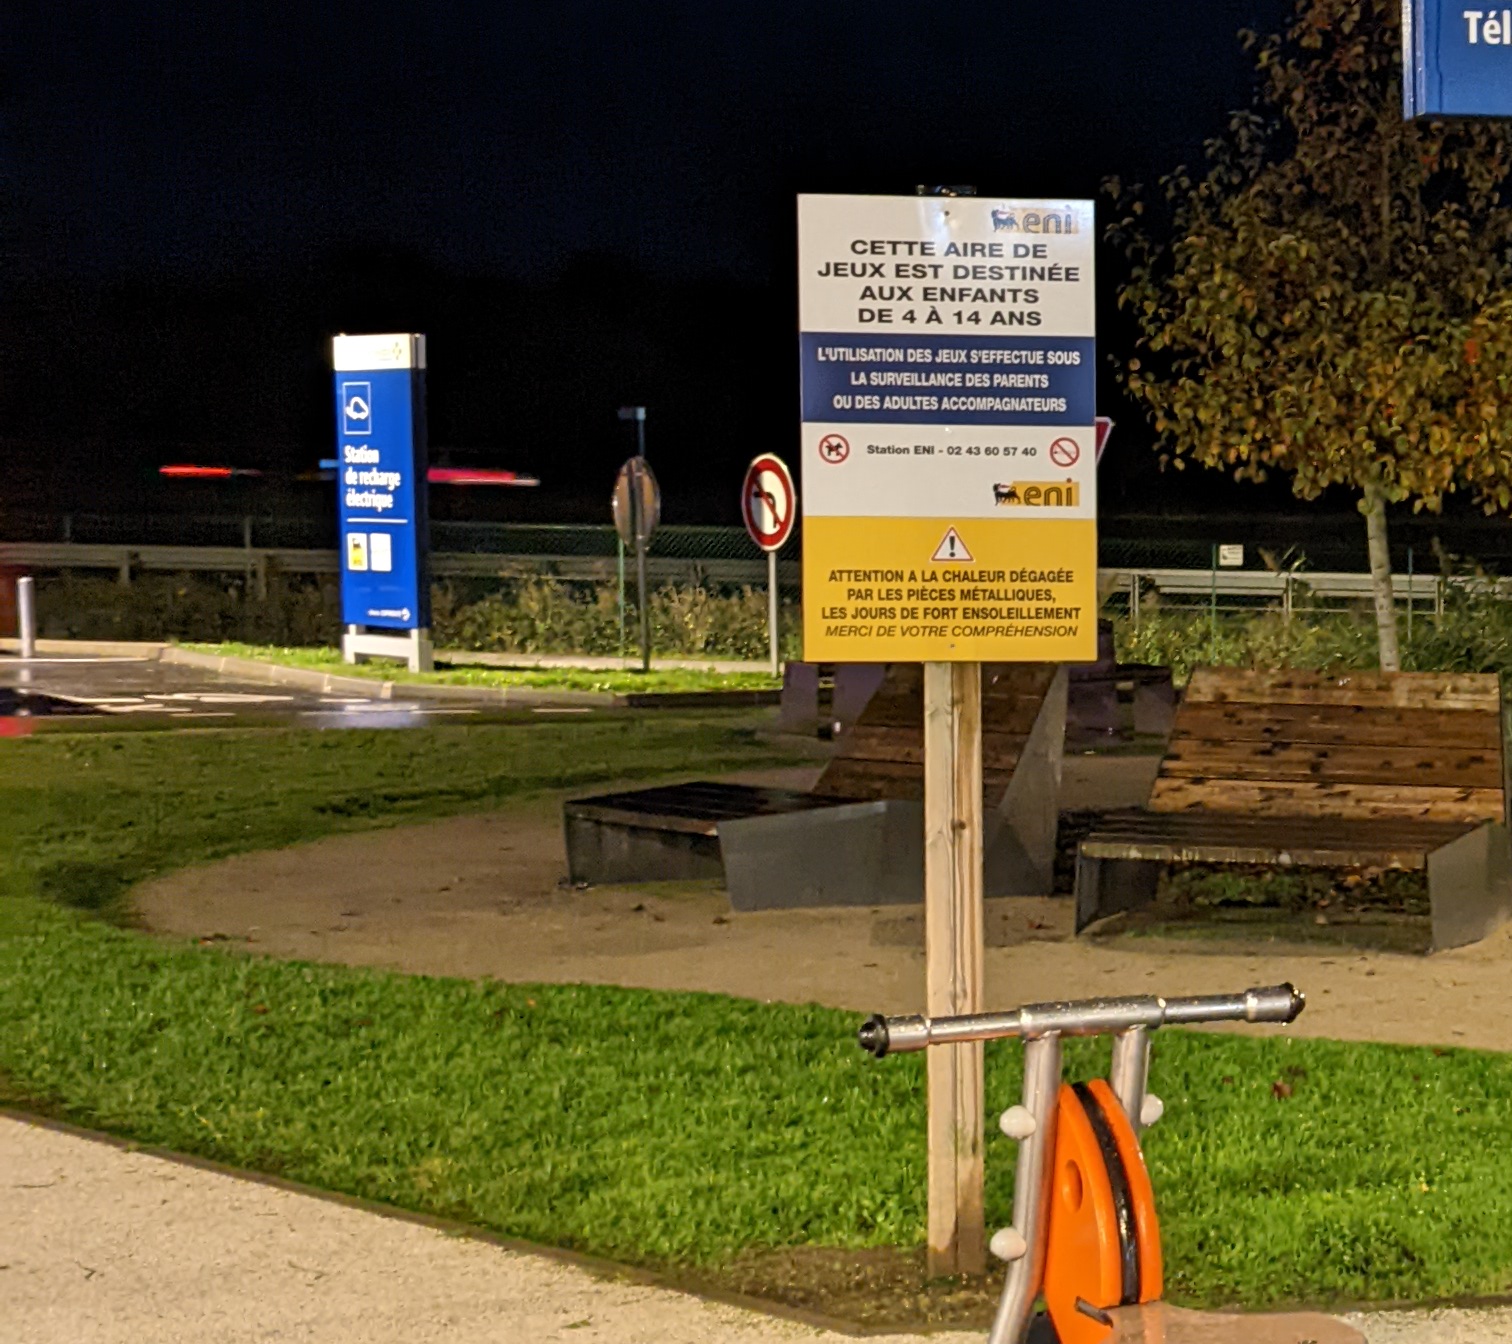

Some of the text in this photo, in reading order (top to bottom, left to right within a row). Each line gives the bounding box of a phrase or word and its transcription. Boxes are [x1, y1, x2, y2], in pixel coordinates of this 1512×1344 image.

[1022, 204, 1072, 234] eni
[851, 239, 1048, 259] CETTE AIRE DE
[817, 262, 1080, 282] JEUX EST DESTINÉE
[859, 286, 1039, 304] AUX ENFANTS
[858, 306, 1042, 326] DE 4 À 14 ANS
[817, 347, 1080, 365] L'UTILISATION DES JEUX S'EFFECTUE SOUS
[850, 371, 1049, 388] LA SURVEILLANCE DES PARENTS
[833, 394, 1067, 412] OU DES ADULTES ACCOMPAGNATEURS
[344, 444, 379, 464] Station
[867, 444, 910, 455] Station
[914, 445, 935, 455] ENI
[947, 445, 962, 456] 02
[965, 445, 981, 456] 43
[984, 446, 1000, 456] 60
[1003, 446, 1018, 456] 57
[1021, 446, 1037, 457] 40
[1023, 477, 1073, 506] eni
[828, 567, 1074, 583] ATTENTION A LA CHALEUR DÉGAGÉE
[847, 585, 1056, 603] PAR LES PIÈCES MÉTALLIQUES,
[821, 607, 1082, 620] LES JOURS DE FORT ENSOLEILLEMENT
[825, 623, 1078, 638] MERCI DE VOTRE COMPRÉHENSION
